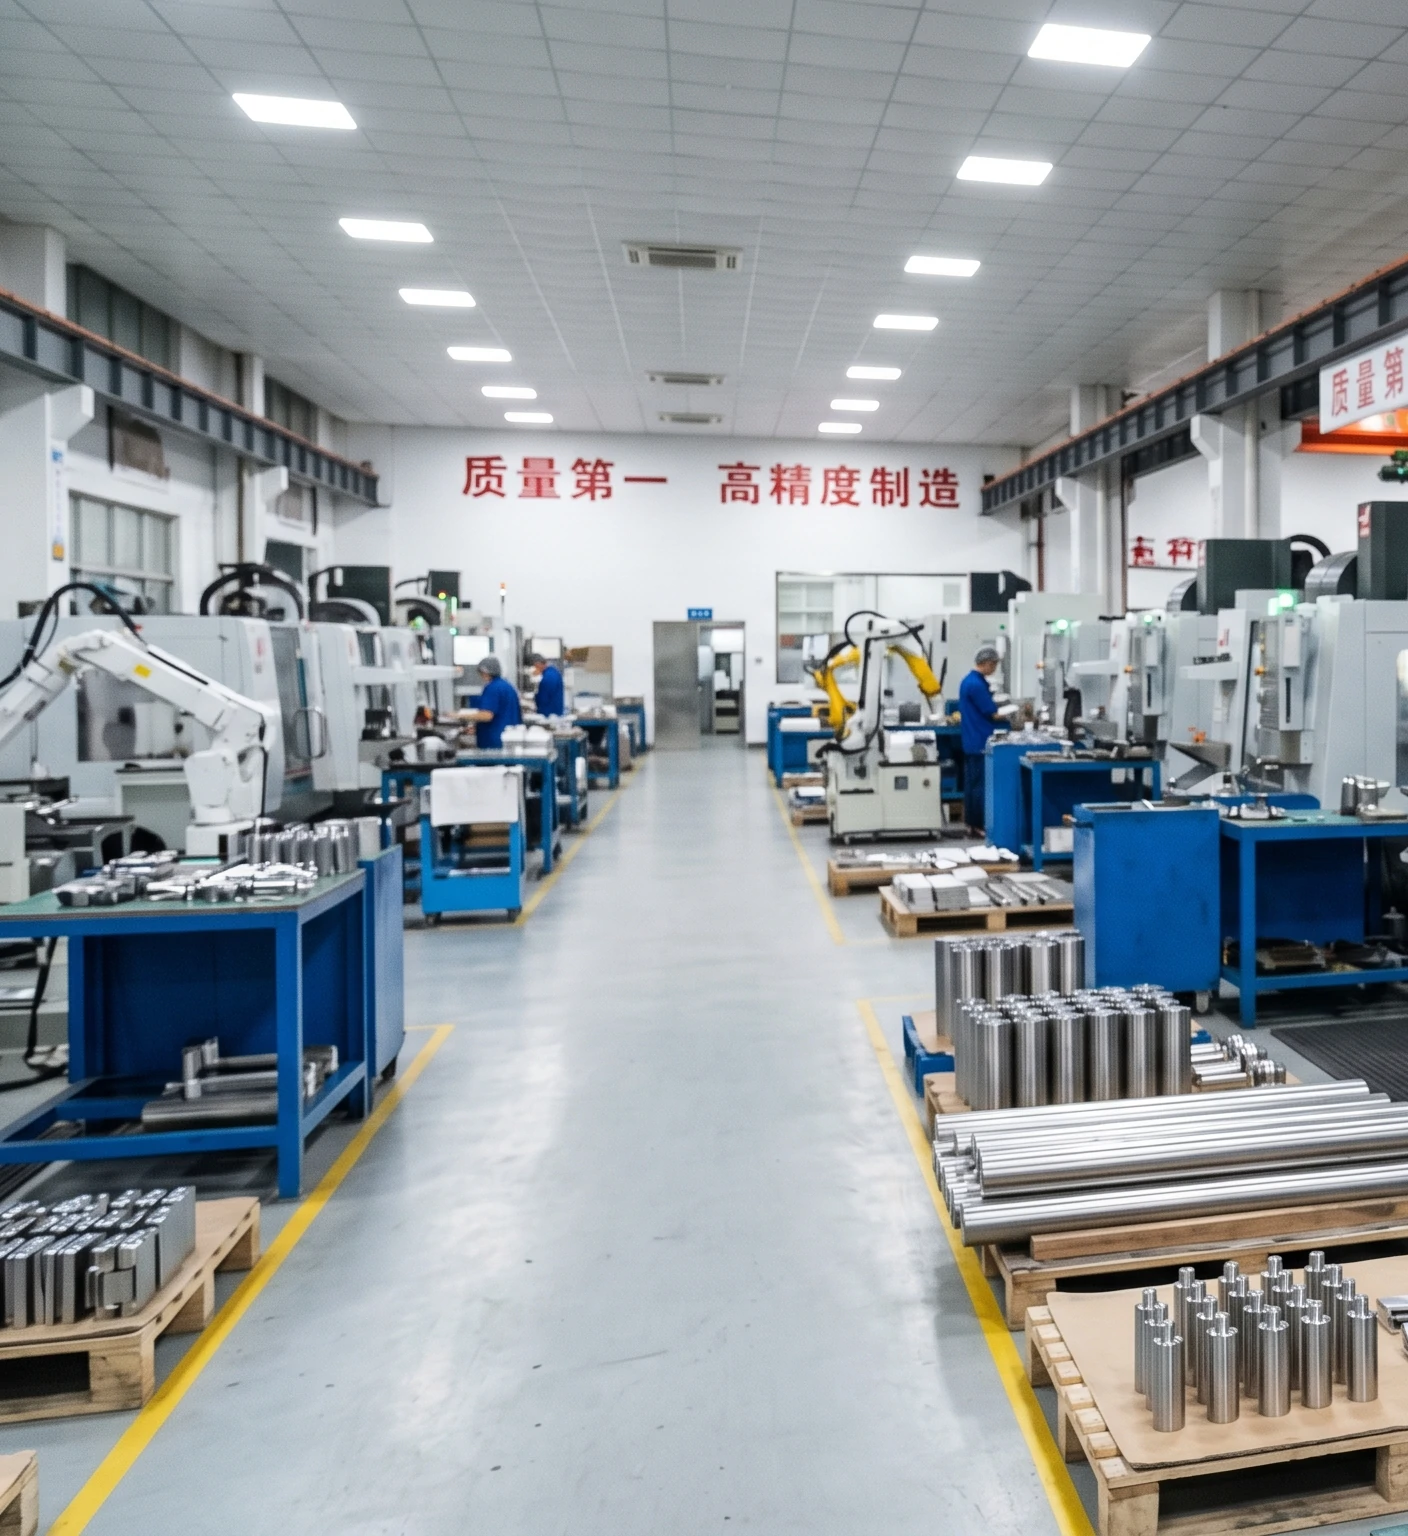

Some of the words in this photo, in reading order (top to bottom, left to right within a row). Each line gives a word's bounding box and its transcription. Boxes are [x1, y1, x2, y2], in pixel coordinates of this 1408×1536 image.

[462, 456, 668, 501] 质量第一
[718, 462, 961, 509] 高精度制造
